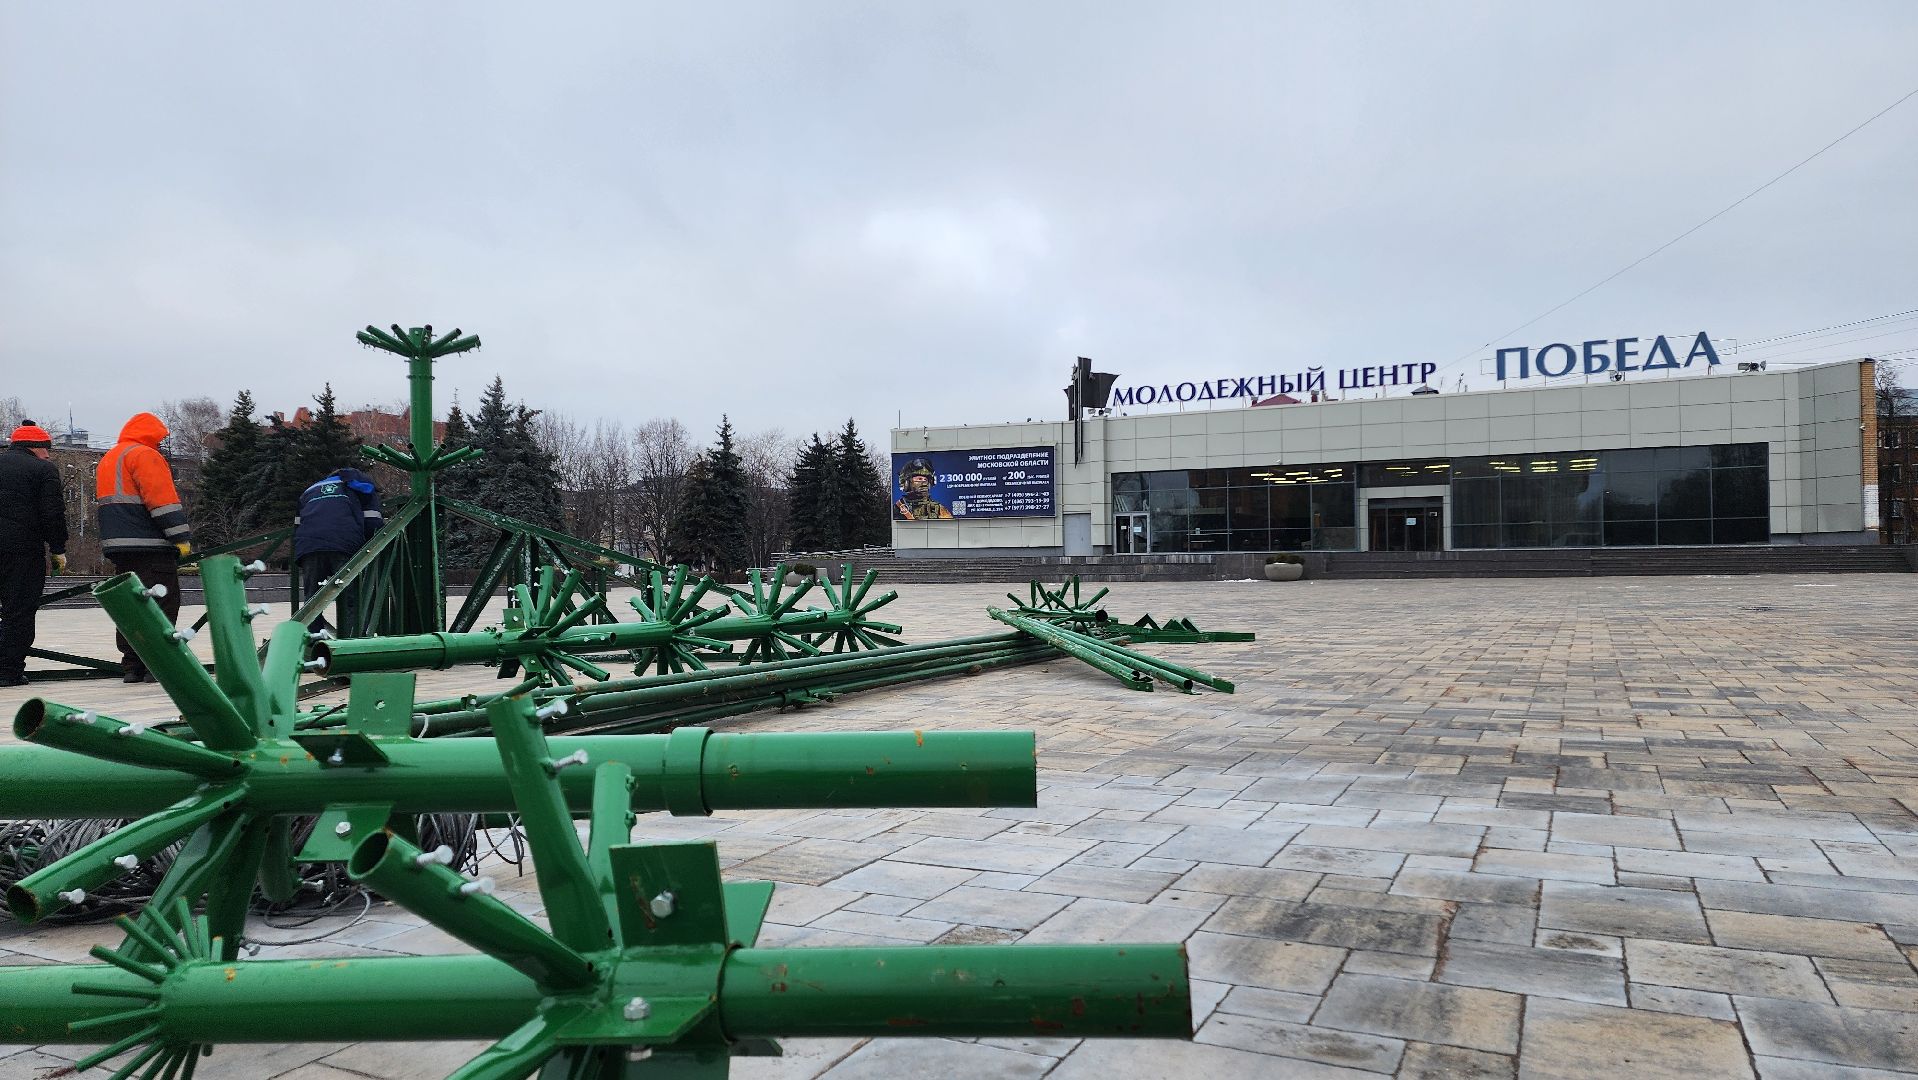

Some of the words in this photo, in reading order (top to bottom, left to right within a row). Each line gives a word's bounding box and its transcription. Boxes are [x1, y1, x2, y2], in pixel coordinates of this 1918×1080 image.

[1496, 331, 1721, 381] ПОБЕДА
[1113, 366, 1325, 406] МОЛОДЕЖНЫЙ
[1339, 362, 1437, 389] ЦЕНТР
[977, 460, 1019, 468] МОСКОВСКОЙ
[1020, 459, 1049, 467] ОБЛАСТИ
[939, 474, 946, 482] 2
[947, 473, 964, 482] 300
[965, 472, 982, 481] 000
[1008, 471, 1025, 480] 200
